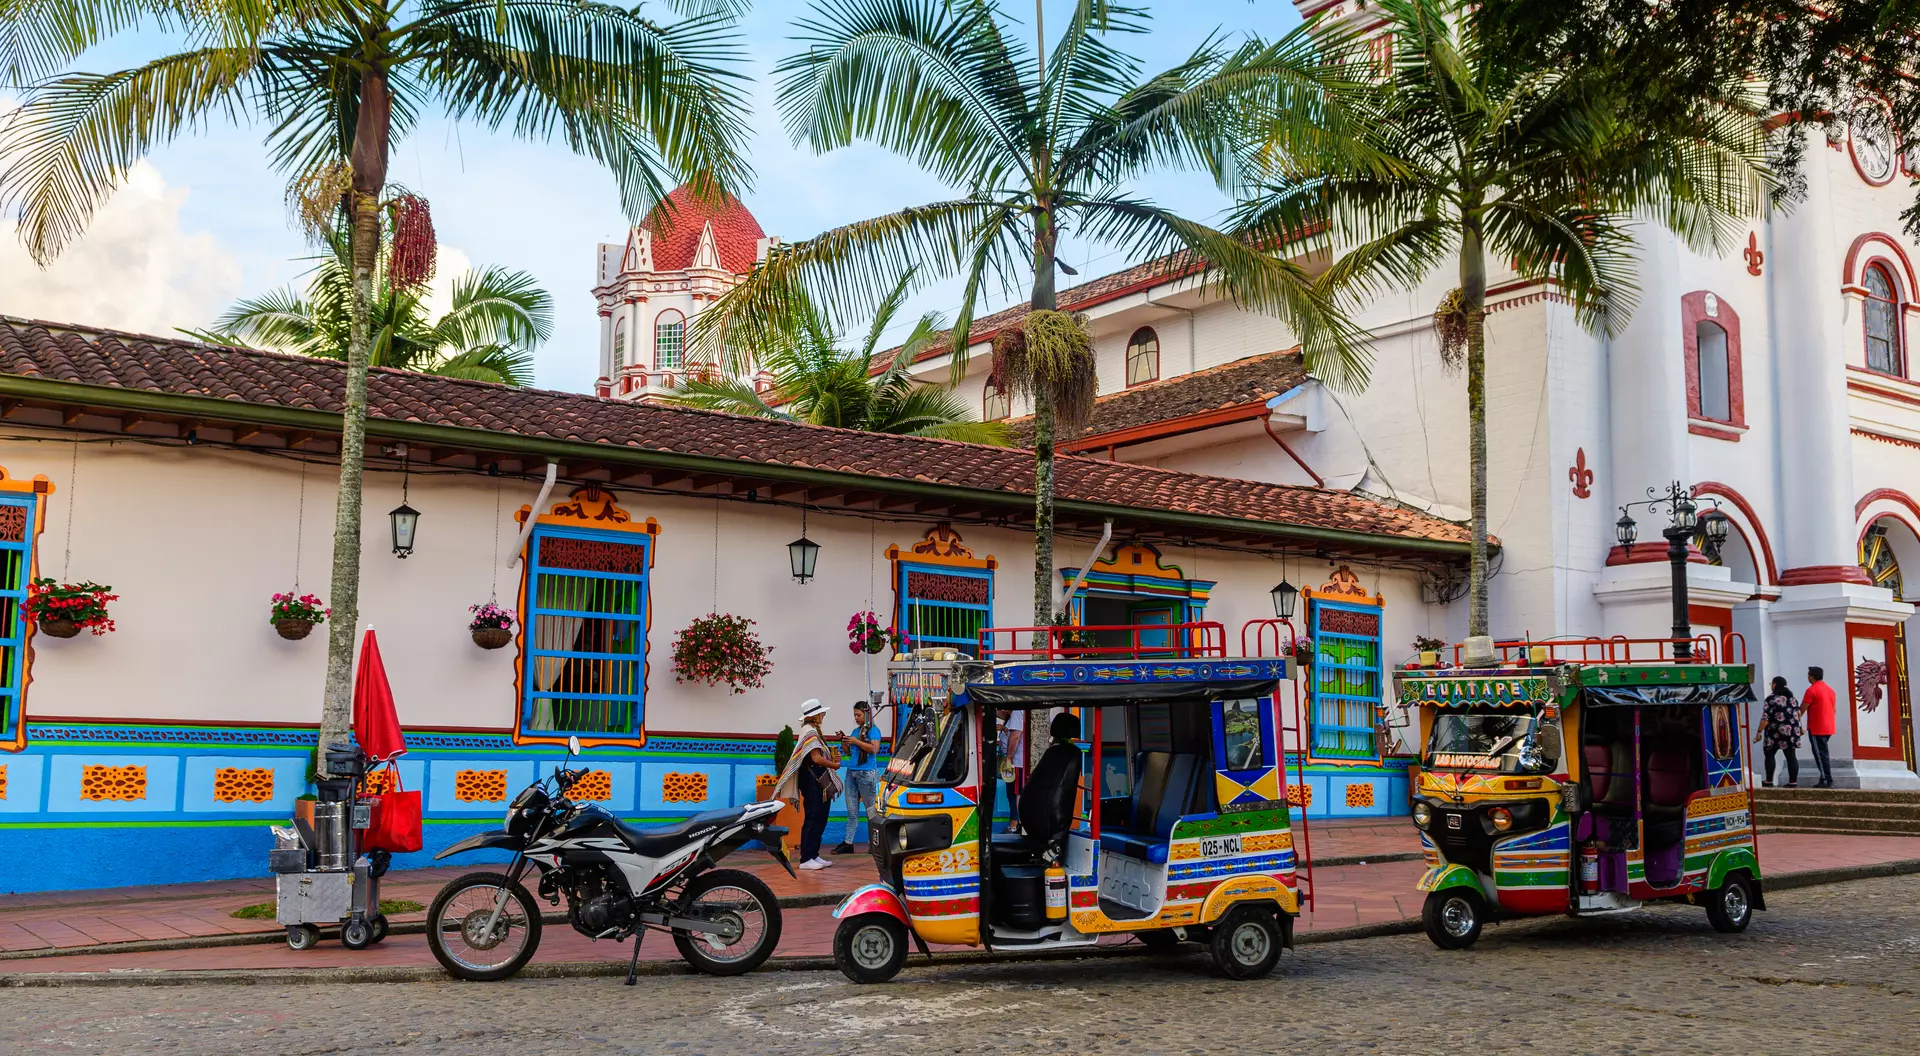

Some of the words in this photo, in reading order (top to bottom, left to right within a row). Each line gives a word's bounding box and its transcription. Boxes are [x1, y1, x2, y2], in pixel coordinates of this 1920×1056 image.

[1426, 682, 1521, 698] GUATAPE
[1435, 754, 1450, 767] LAS
[688, 825, 717, 839] HONDA
[1202, 838, 1239, 856] 025-NCL
[940, 849, 971, 873] 22
